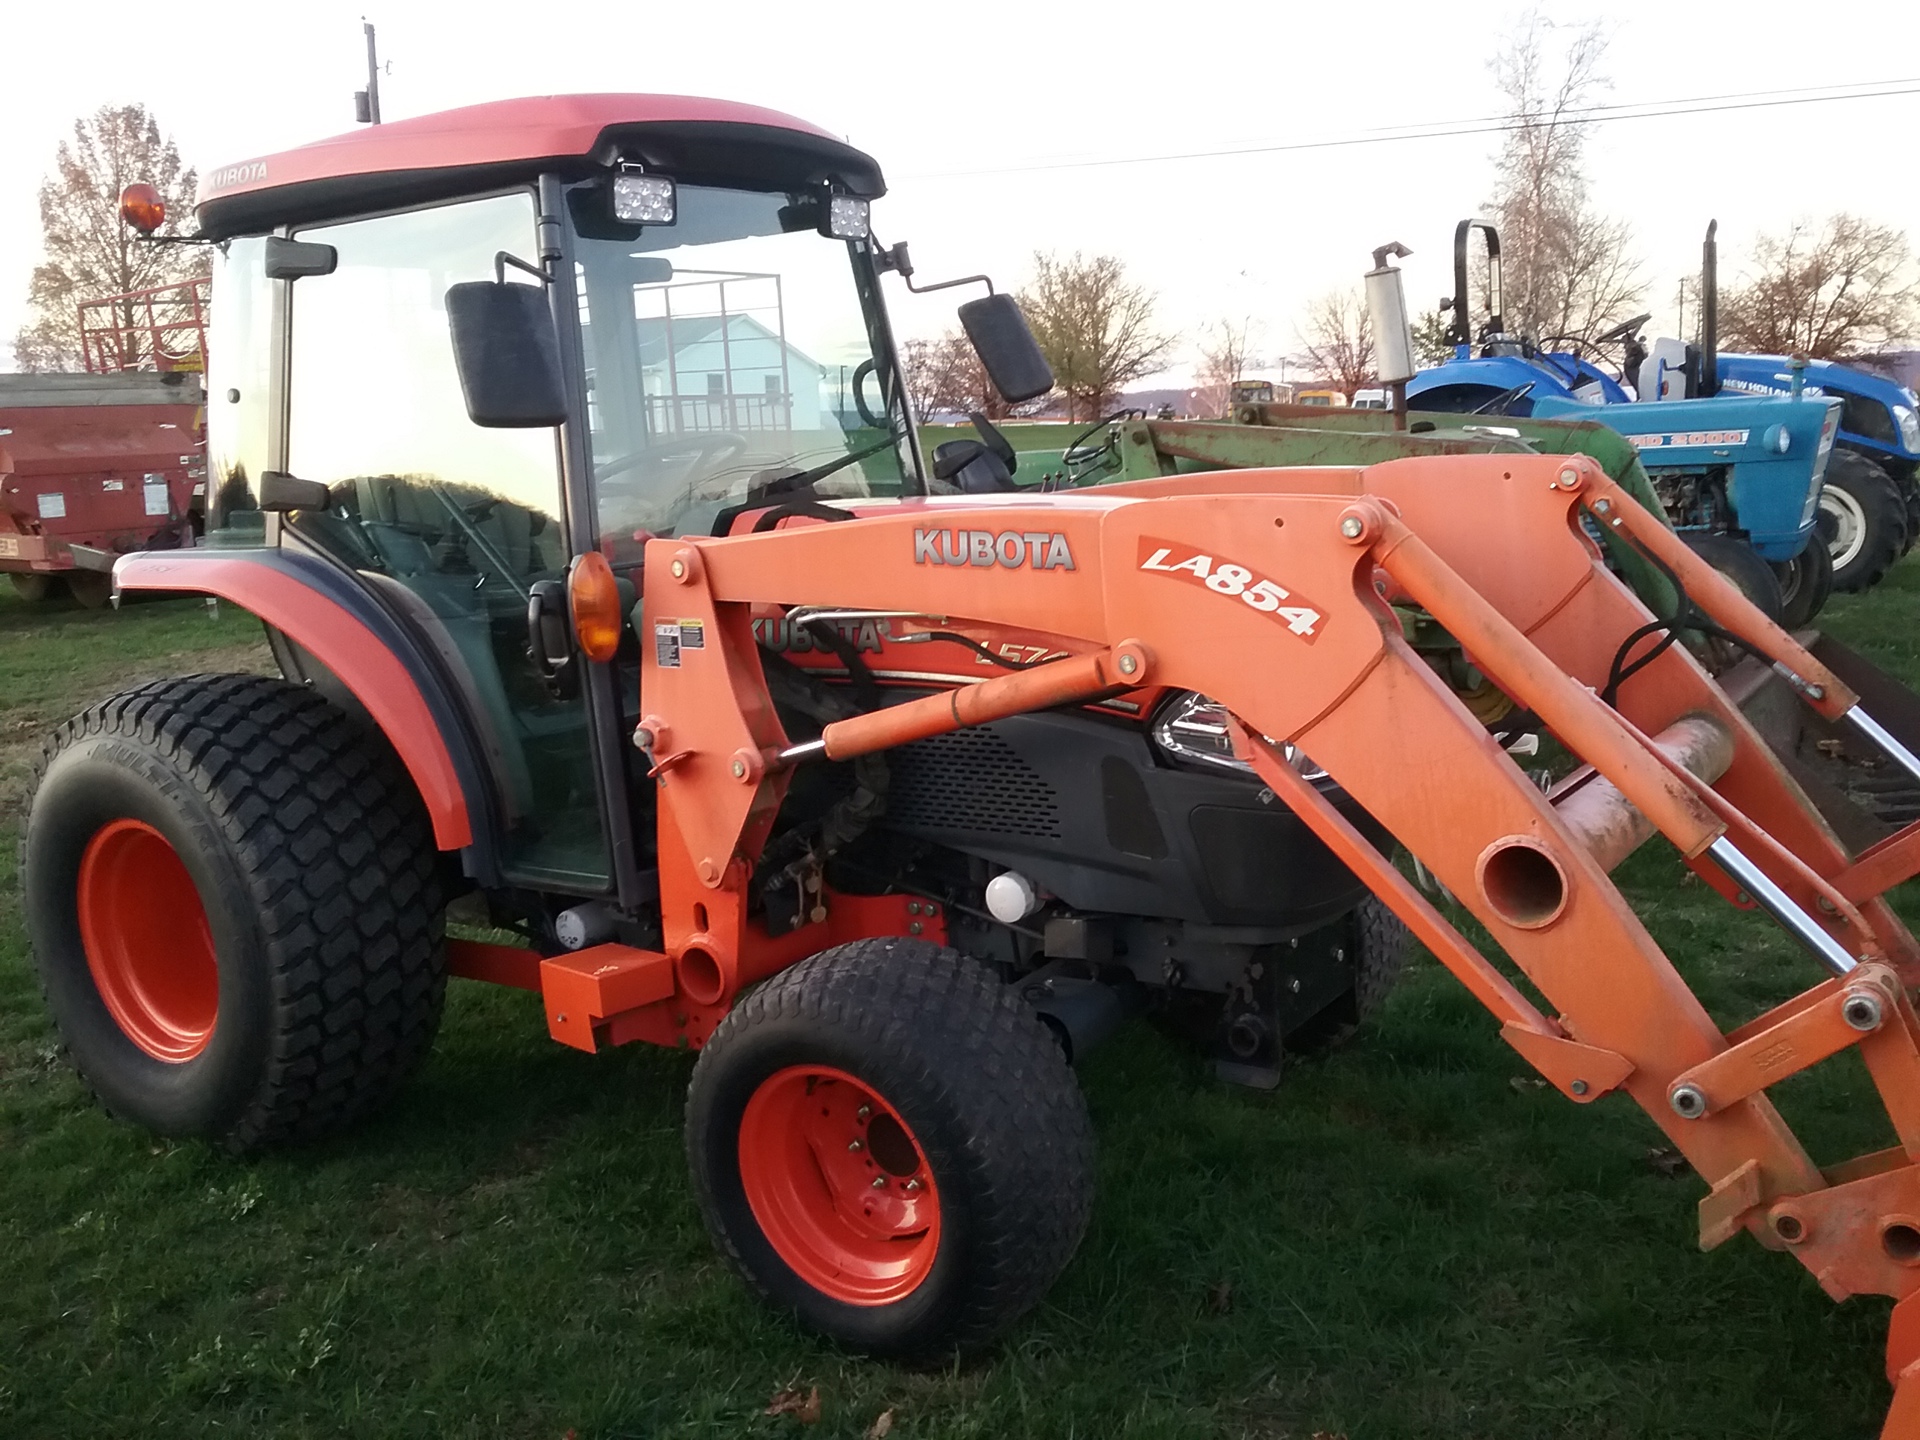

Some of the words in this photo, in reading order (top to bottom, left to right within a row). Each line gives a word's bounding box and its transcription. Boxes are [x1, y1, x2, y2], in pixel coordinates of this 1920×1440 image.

[1722, 379, 1748, 391] NEW
[1748, 382, 1793, 398] HOLLAN
[1670, 432, 1741, 446] 2000
[914, 528, 1077, 571] KUBOTA
[1140, 548, 1321, 636] LA854
